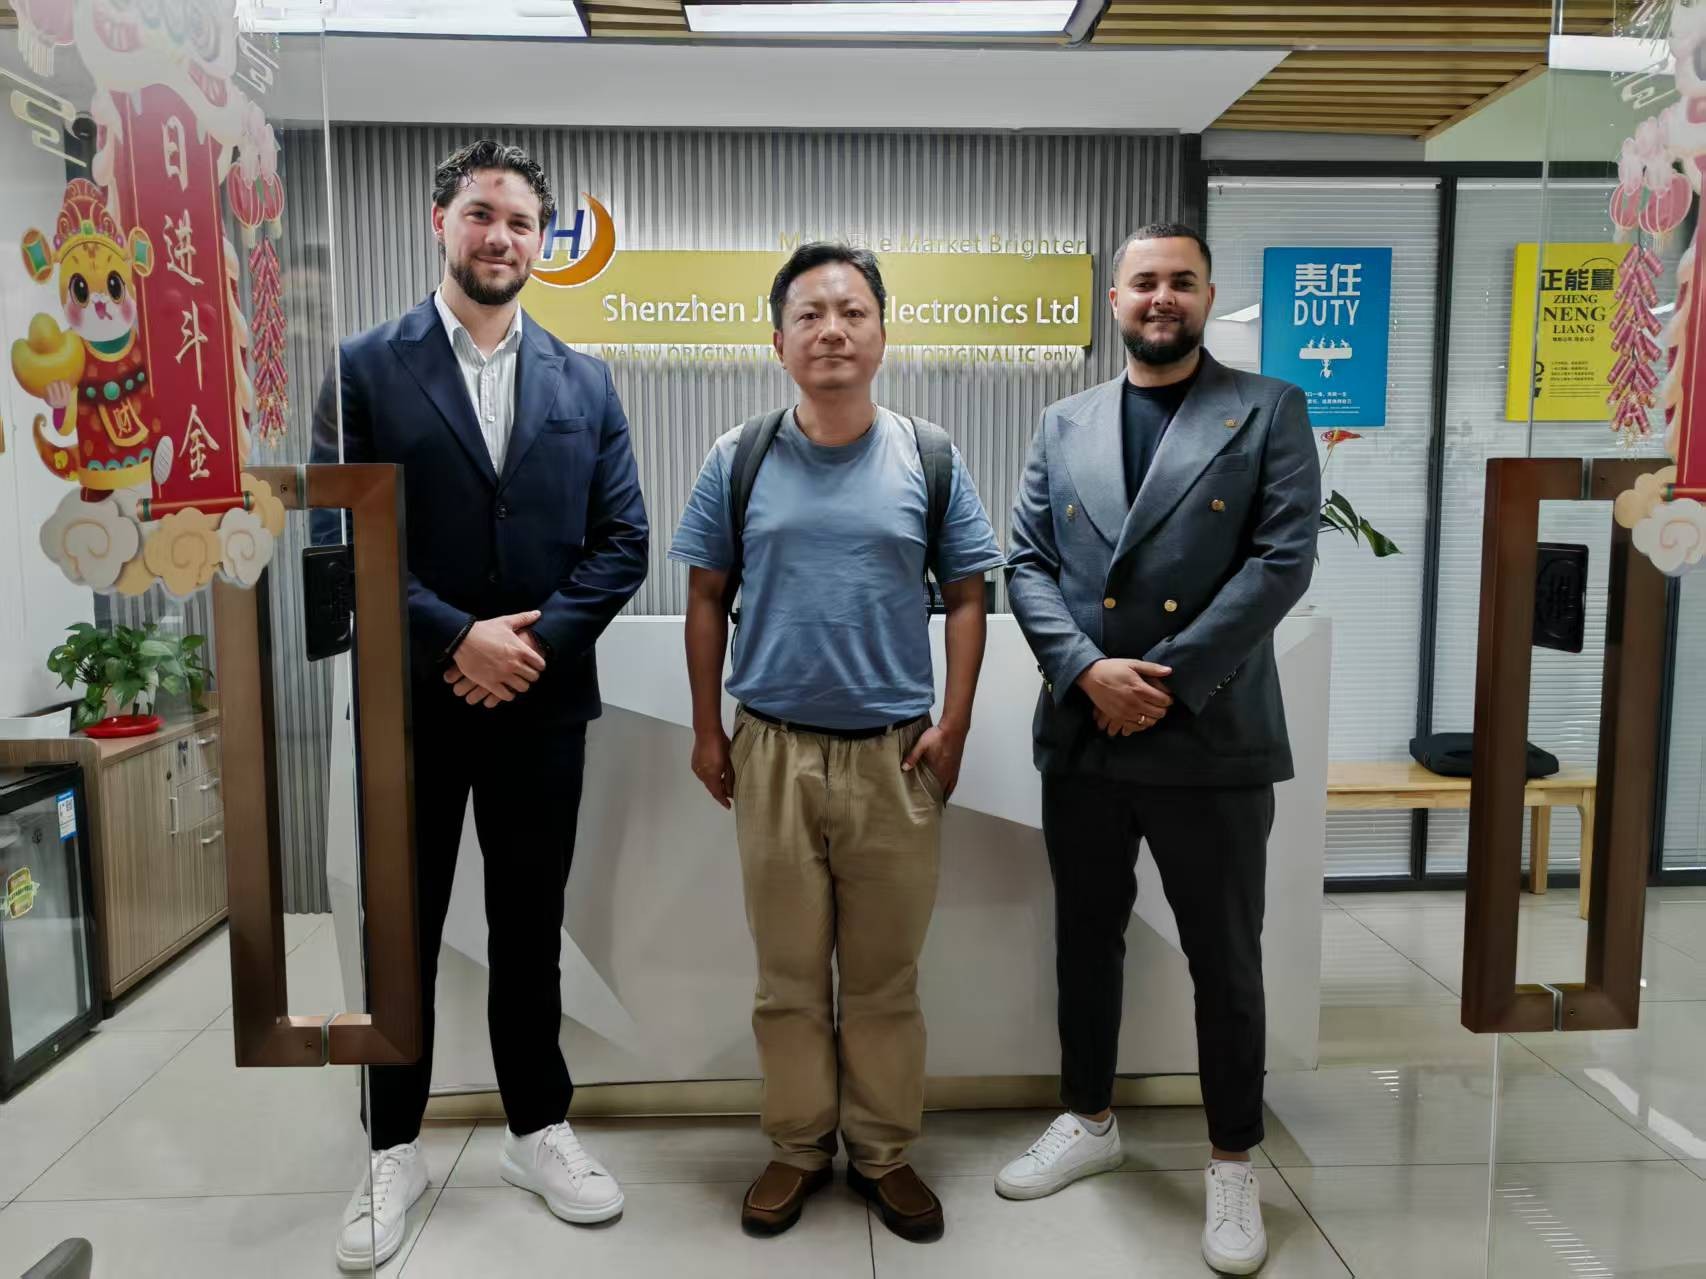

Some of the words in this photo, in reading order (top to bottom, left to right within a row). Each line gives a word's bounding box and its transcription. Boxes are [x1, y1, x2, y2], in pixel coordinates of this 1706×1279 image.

[990, 233, 1086, 259] Brighter
[1295, 263, 1362, 297] 责任
[1541, 268, 1616, 291] 正能量
[161, 115, 219, 481] 日进斗金
[602, 294, 745, 322] Shenzhen
[883, 295, 1028, 324] lectronics
[1036, 296, 1079, 324] Ltd
[1553, 294, 1598, 304] ZHENG
[1294, 299, 1360, 326] DUTY
[1543, 306, 1606, 322] NENG
[1553, 324, 1595, 334] LIANG
[1018, 347, 1036, 362] IC
[1044, 346, 1077, 364] only
